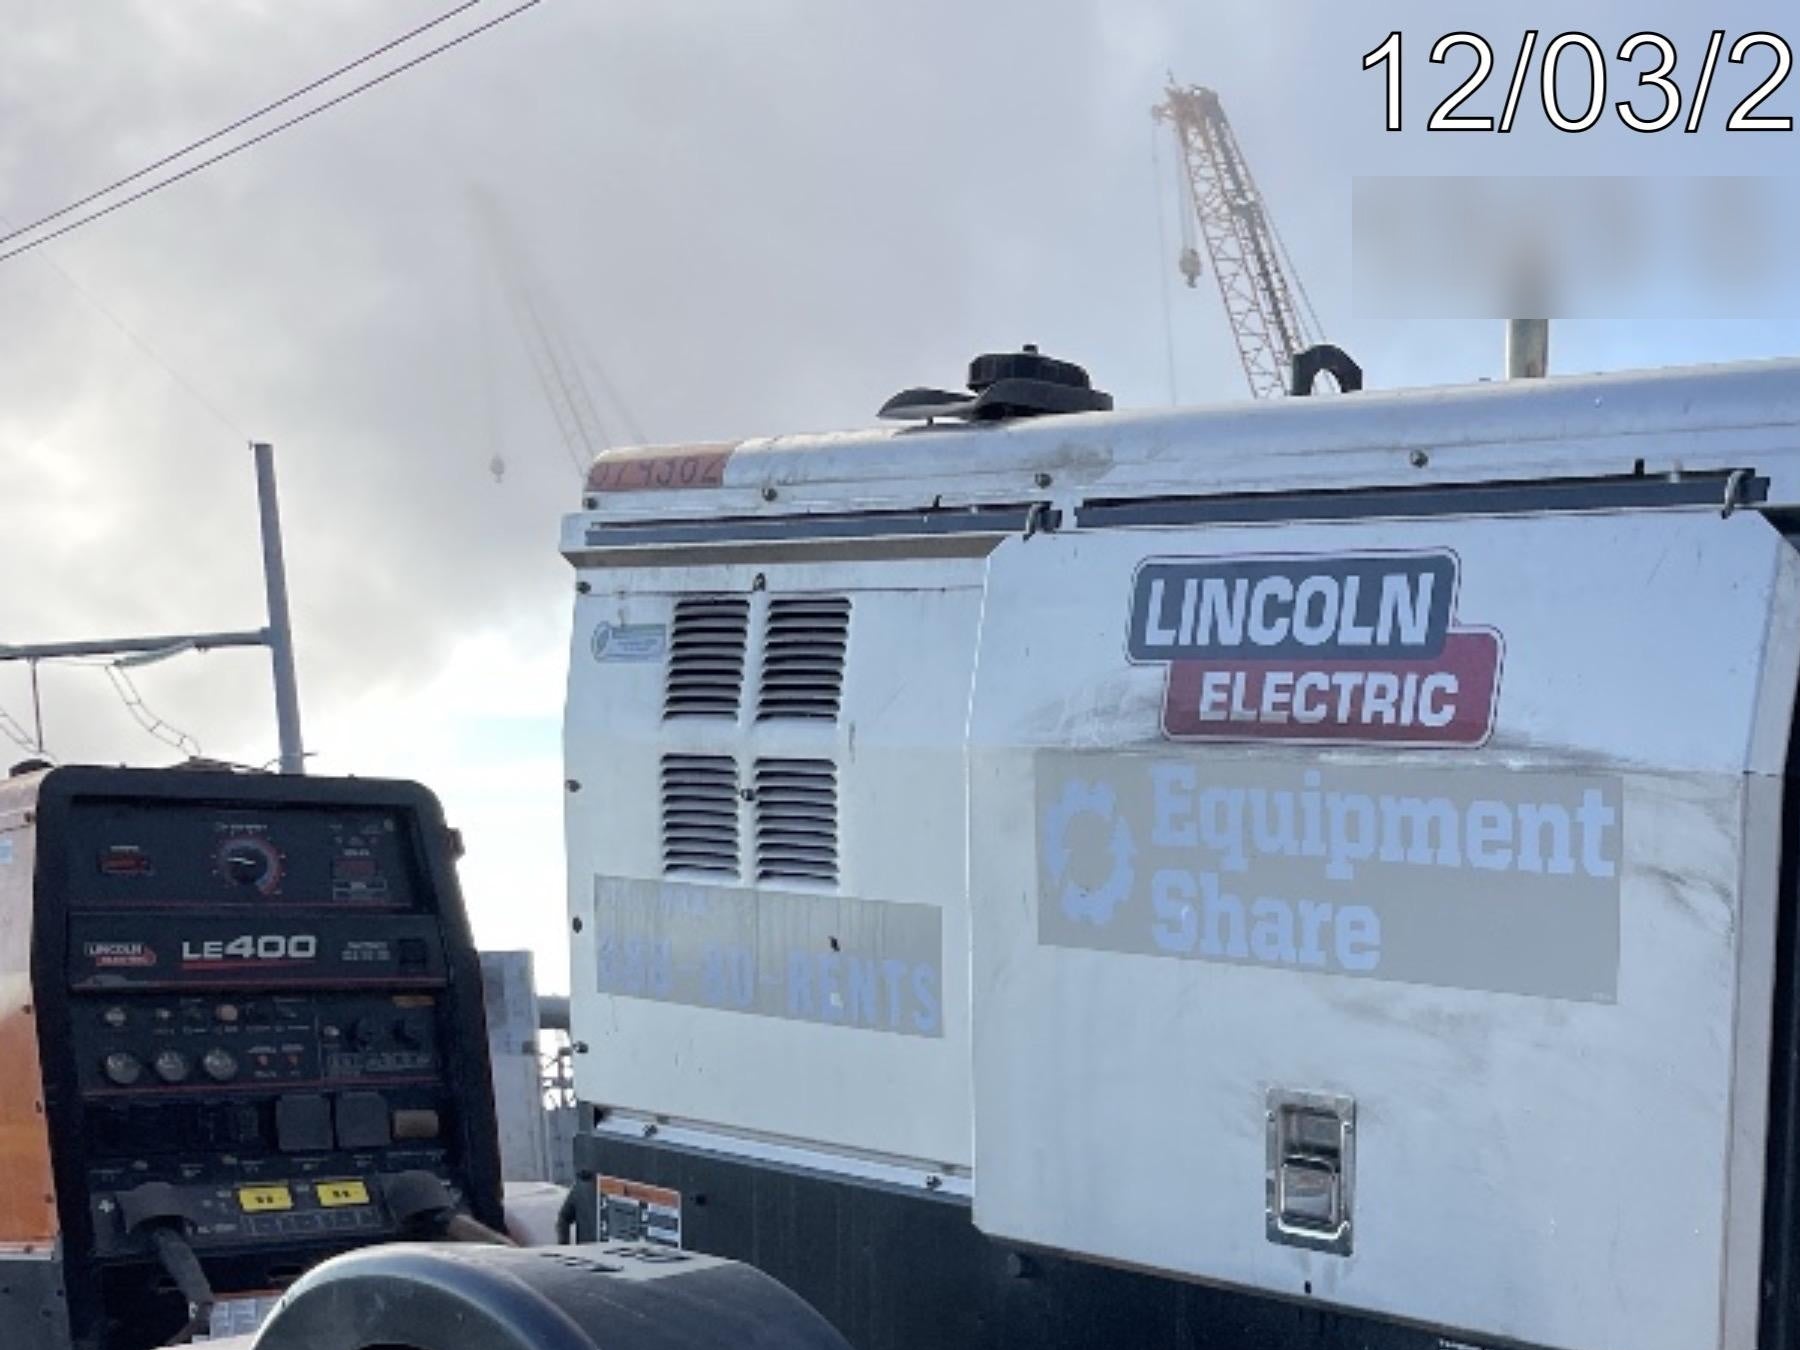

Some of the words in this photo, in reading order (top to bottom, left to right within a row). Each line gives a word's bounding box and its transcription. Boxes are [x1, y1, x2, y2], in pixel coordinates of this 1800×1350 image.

[1145, 571, 1434, 647] LINCOLN
[1199, 671, 1458, 727] ELECTRIC
[1149, 762, 1616, 880] Equipment
[182, 935, 317, 960] LE400
[1149, 868, 1382, 972] Share
